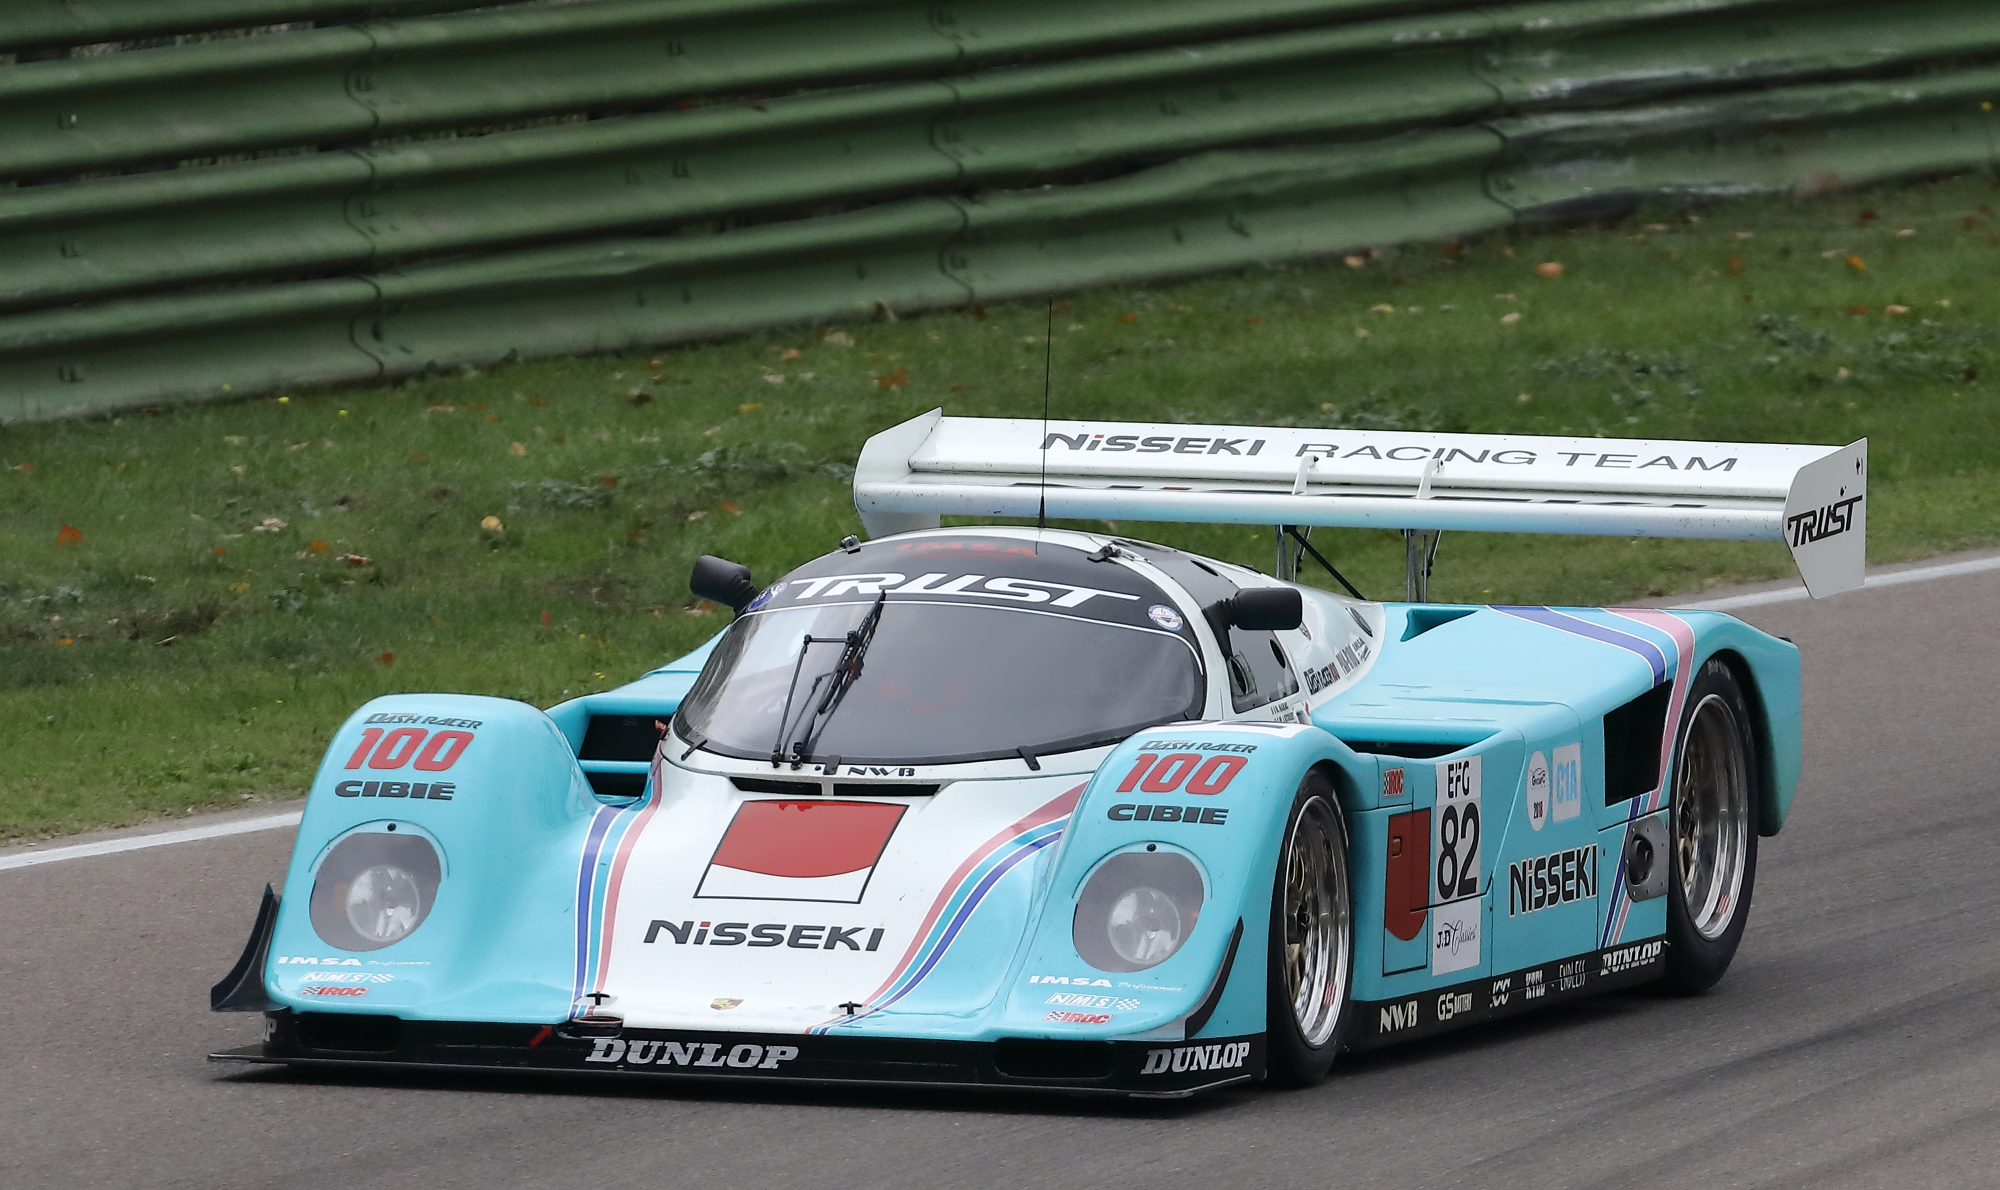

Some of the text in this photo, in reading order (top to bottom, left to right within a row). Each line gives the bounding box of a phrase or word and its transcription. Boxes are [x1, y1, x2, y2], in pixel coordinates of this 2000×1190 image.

[1295, 443, 1537, 465] RACING
[1557, 451, 1738, 471] TEAM
[1787, 494, 1863, 548] TRUST
[790, 572, 1141, 608] TRUST
[362, 712, 483, 730] DASH RACER
[343, 727, 475, 772] 100
[1137, 740, 1258, 754] DASH RACER
[847, 766, 916, 777] NWB
[1115, 753, 1249, 796] 100
[1447, 760, 1470, 799] EFG
[1437, 802, 1480, 900] 82
[278, 956, 362, 967] IMSA
[1601, 941, 1662, 976] DUNLOP
[317, 986, 367, 997] IROC
[1028, 975, 1113, 988] IMSA
[1060, 1011, 1110, 1025] IROC
[1379, 1000, 1418, 1034] NWB
[1437, 992, 1454, 1021] GS
[585, 1038, 799, 1069] DUNLOP
[1140, 1041, 1251, 1075] DUNLOP
